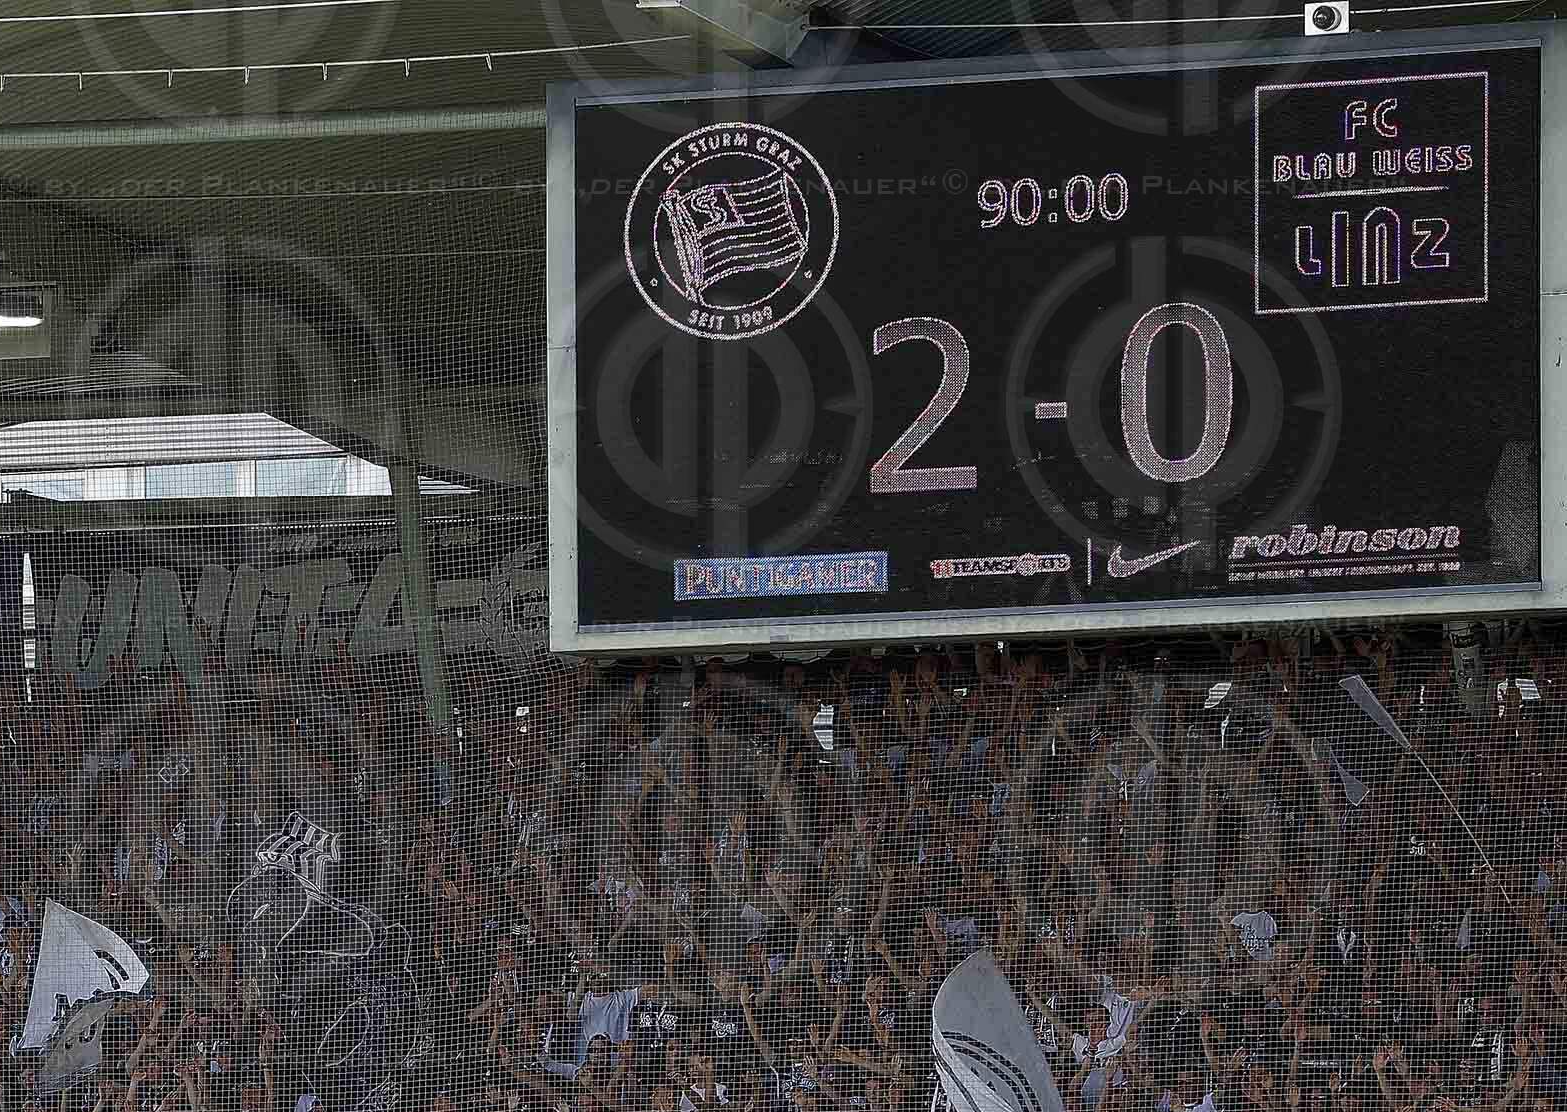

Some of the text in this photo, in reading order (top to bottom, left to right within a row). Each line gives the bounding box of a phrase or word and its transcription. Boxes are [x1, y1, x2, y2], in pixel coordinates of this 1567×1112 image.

[1345, 98, 1398, 140] FC
[662, 132, 803, 176] SK STURM GRAZ
[1273, 145, 1473, 182] BLAU WEISS
[978, 173, 1129, 228] 90:00
[1295, 206, 1450, 288] LINZ
[687, 305, 774, 331] SEIT 1909
[869, 317, 980, 495] 2
[1120, 302, 1234, 484] 0
[1228, 523, 1462, 560] robinson
[684, 556, 880, 596] PUNTIGAMER
